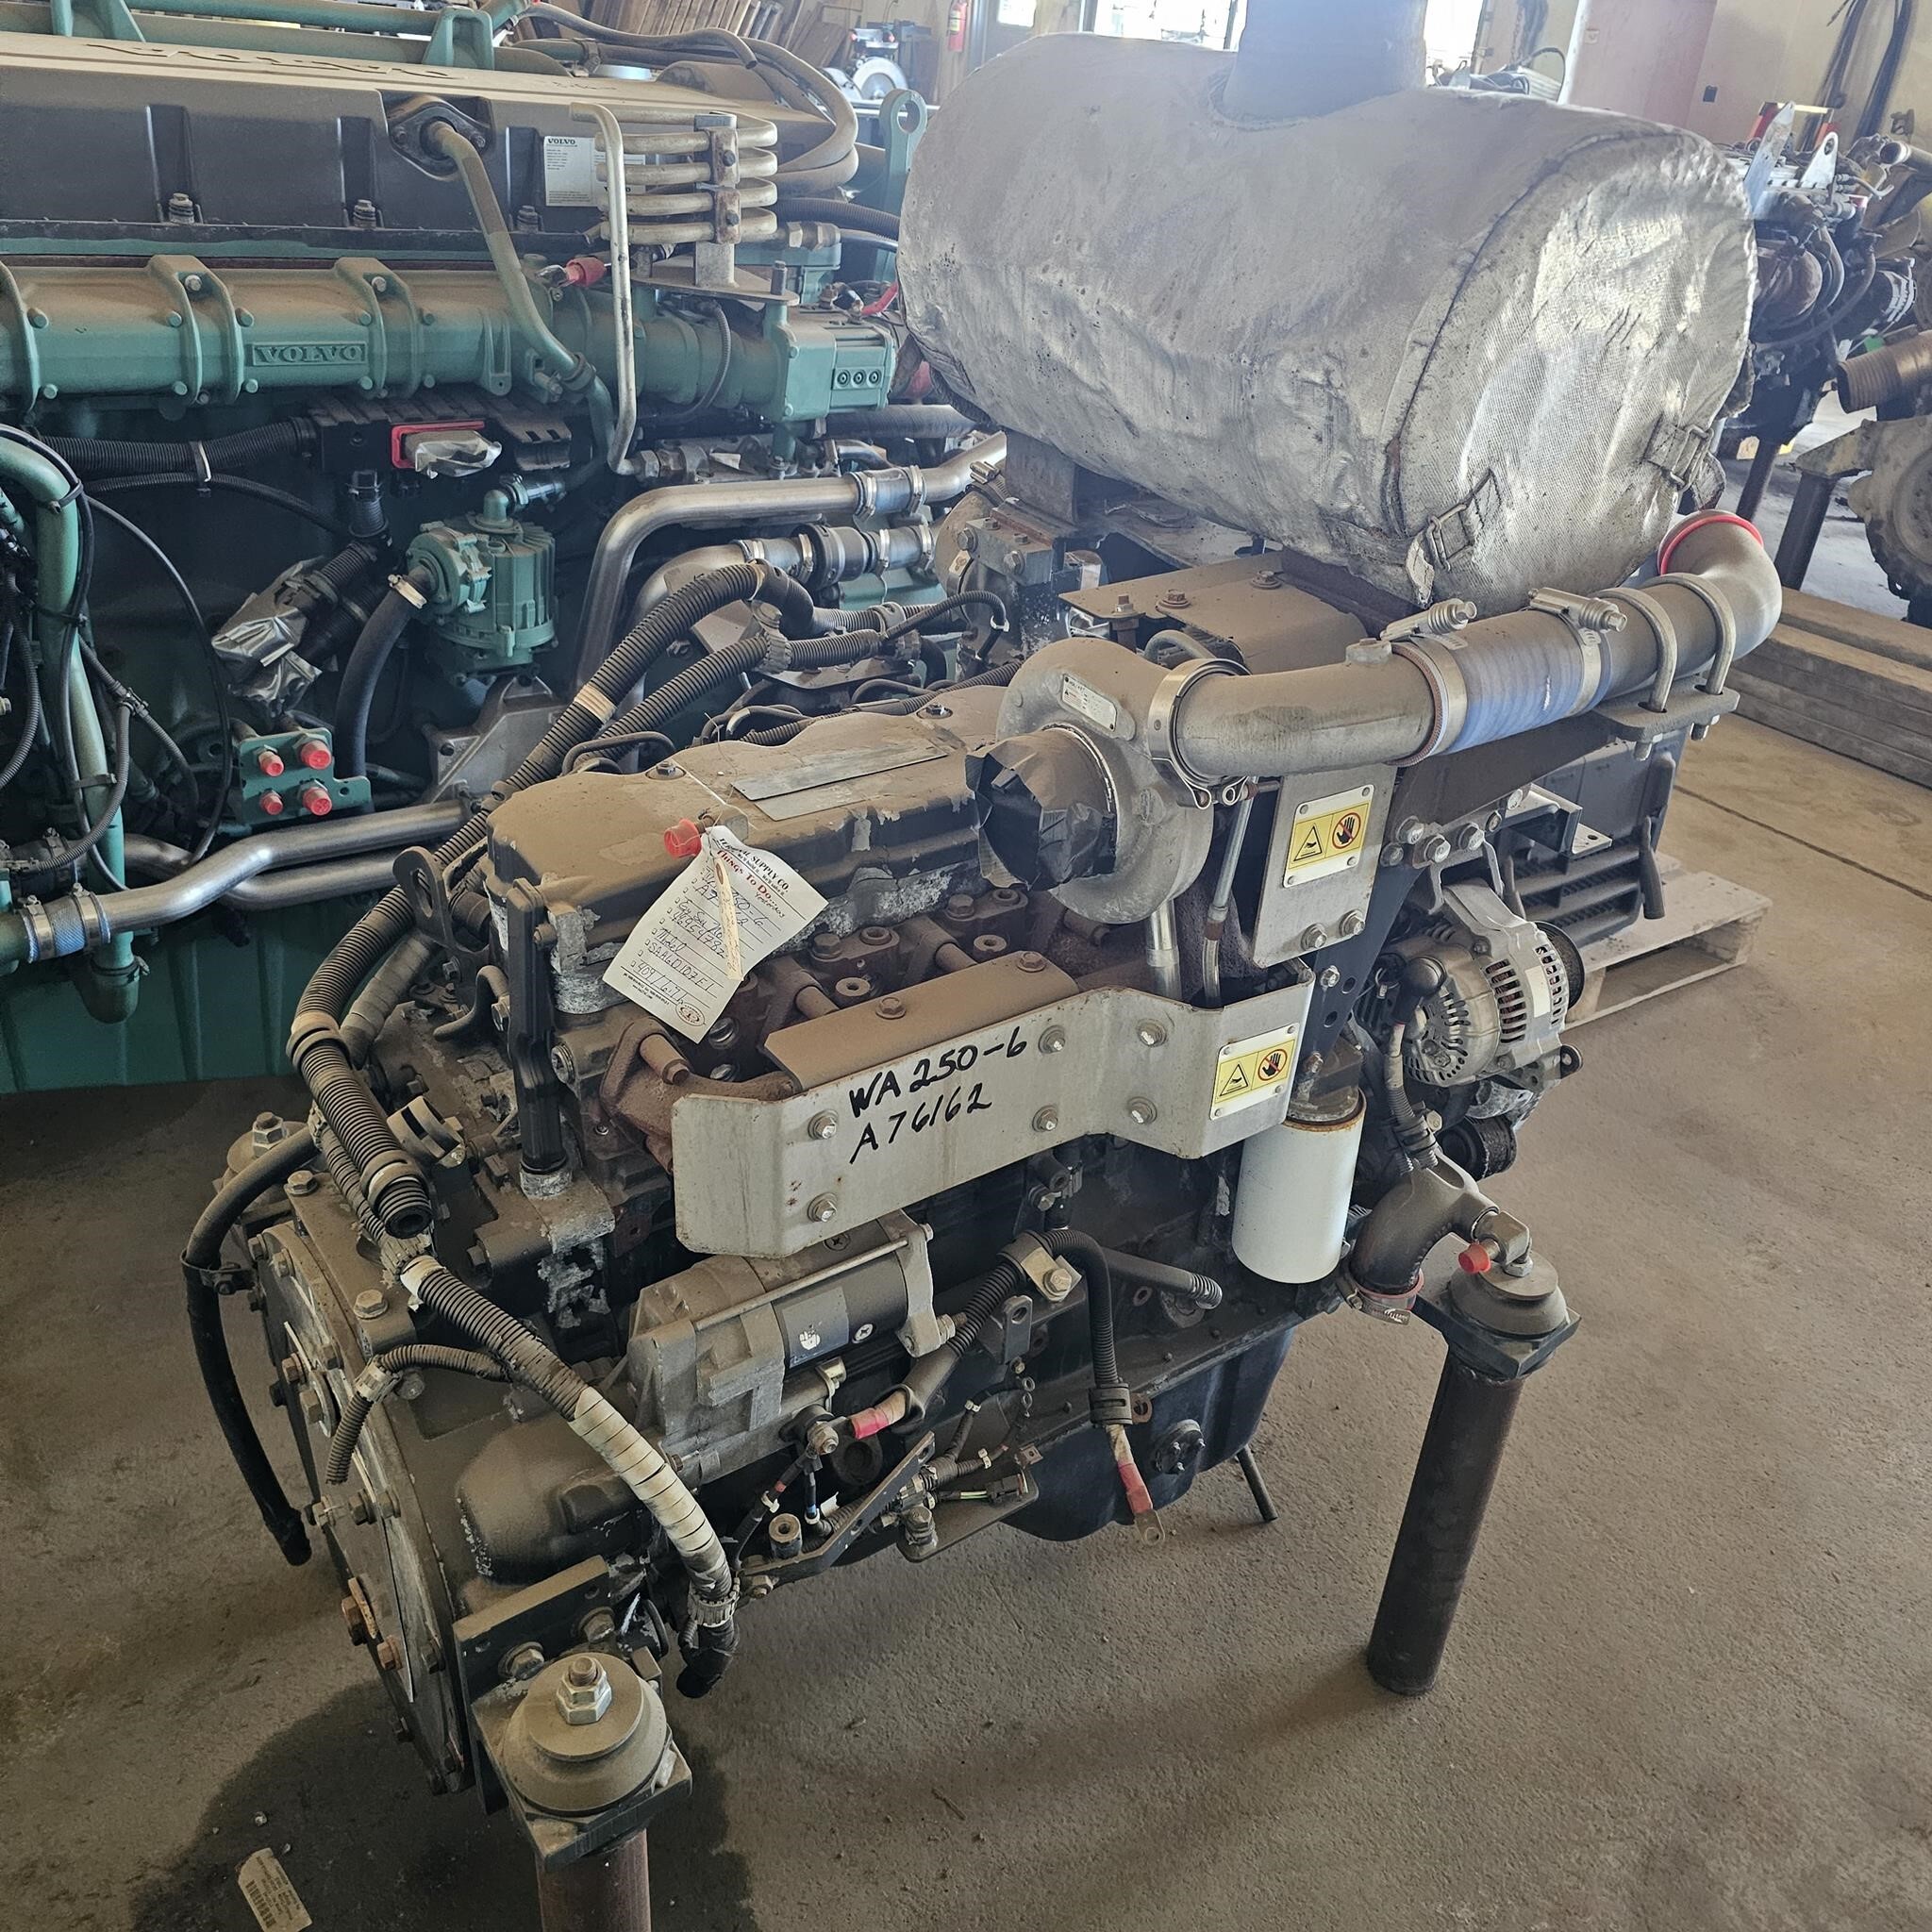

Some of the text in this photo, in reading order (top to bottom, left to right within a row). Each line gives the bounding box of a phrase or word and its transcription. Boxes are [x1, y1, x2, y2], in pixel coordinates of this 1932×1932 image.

[258, 346, 362, 363] VOLVO
[717, 849, 743, 874] Things
[745, 874, 757, 886] To
[751, 856, 778, 879] SUPPLY
[776, 878, 790, 892] CO.
[850, 1083, 992, 1164] A76162
